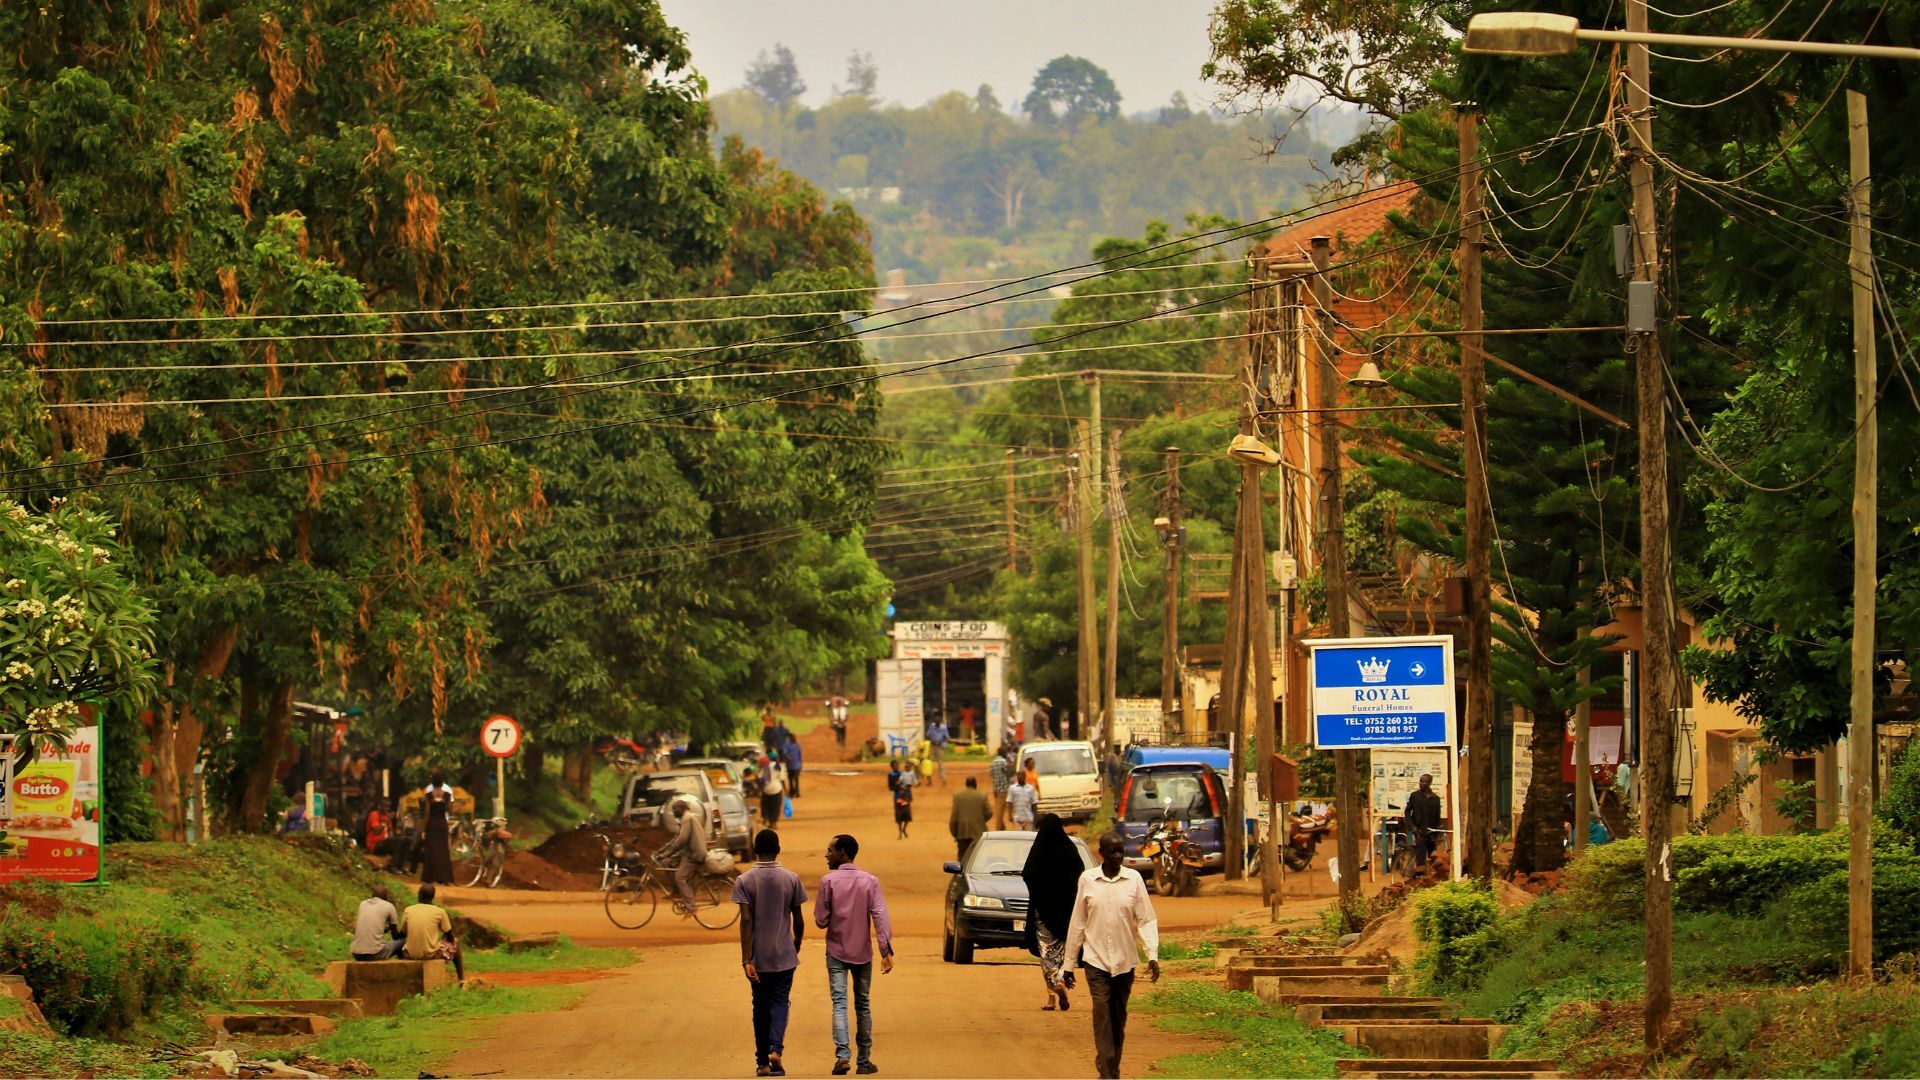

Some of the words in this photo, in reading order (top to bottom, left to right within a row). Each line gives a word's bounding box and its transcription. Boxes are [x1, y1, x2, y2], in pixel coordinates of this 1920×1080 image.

[1355, 689, 1410, 701] ROYAL
[1352, 704, 1384, 712] Funeral
[1344, 718, 1363, 726] TEL:
[1365, 717, 1385, 725] 0752
[1386, 717, 1402, 725] 260
[1365, 726, 1385, 734] 0782
[1387, 726, 1401, 734] 081
[41, 741, 91, 757] Ugnda
[21, 783, 60, 795] Butto
